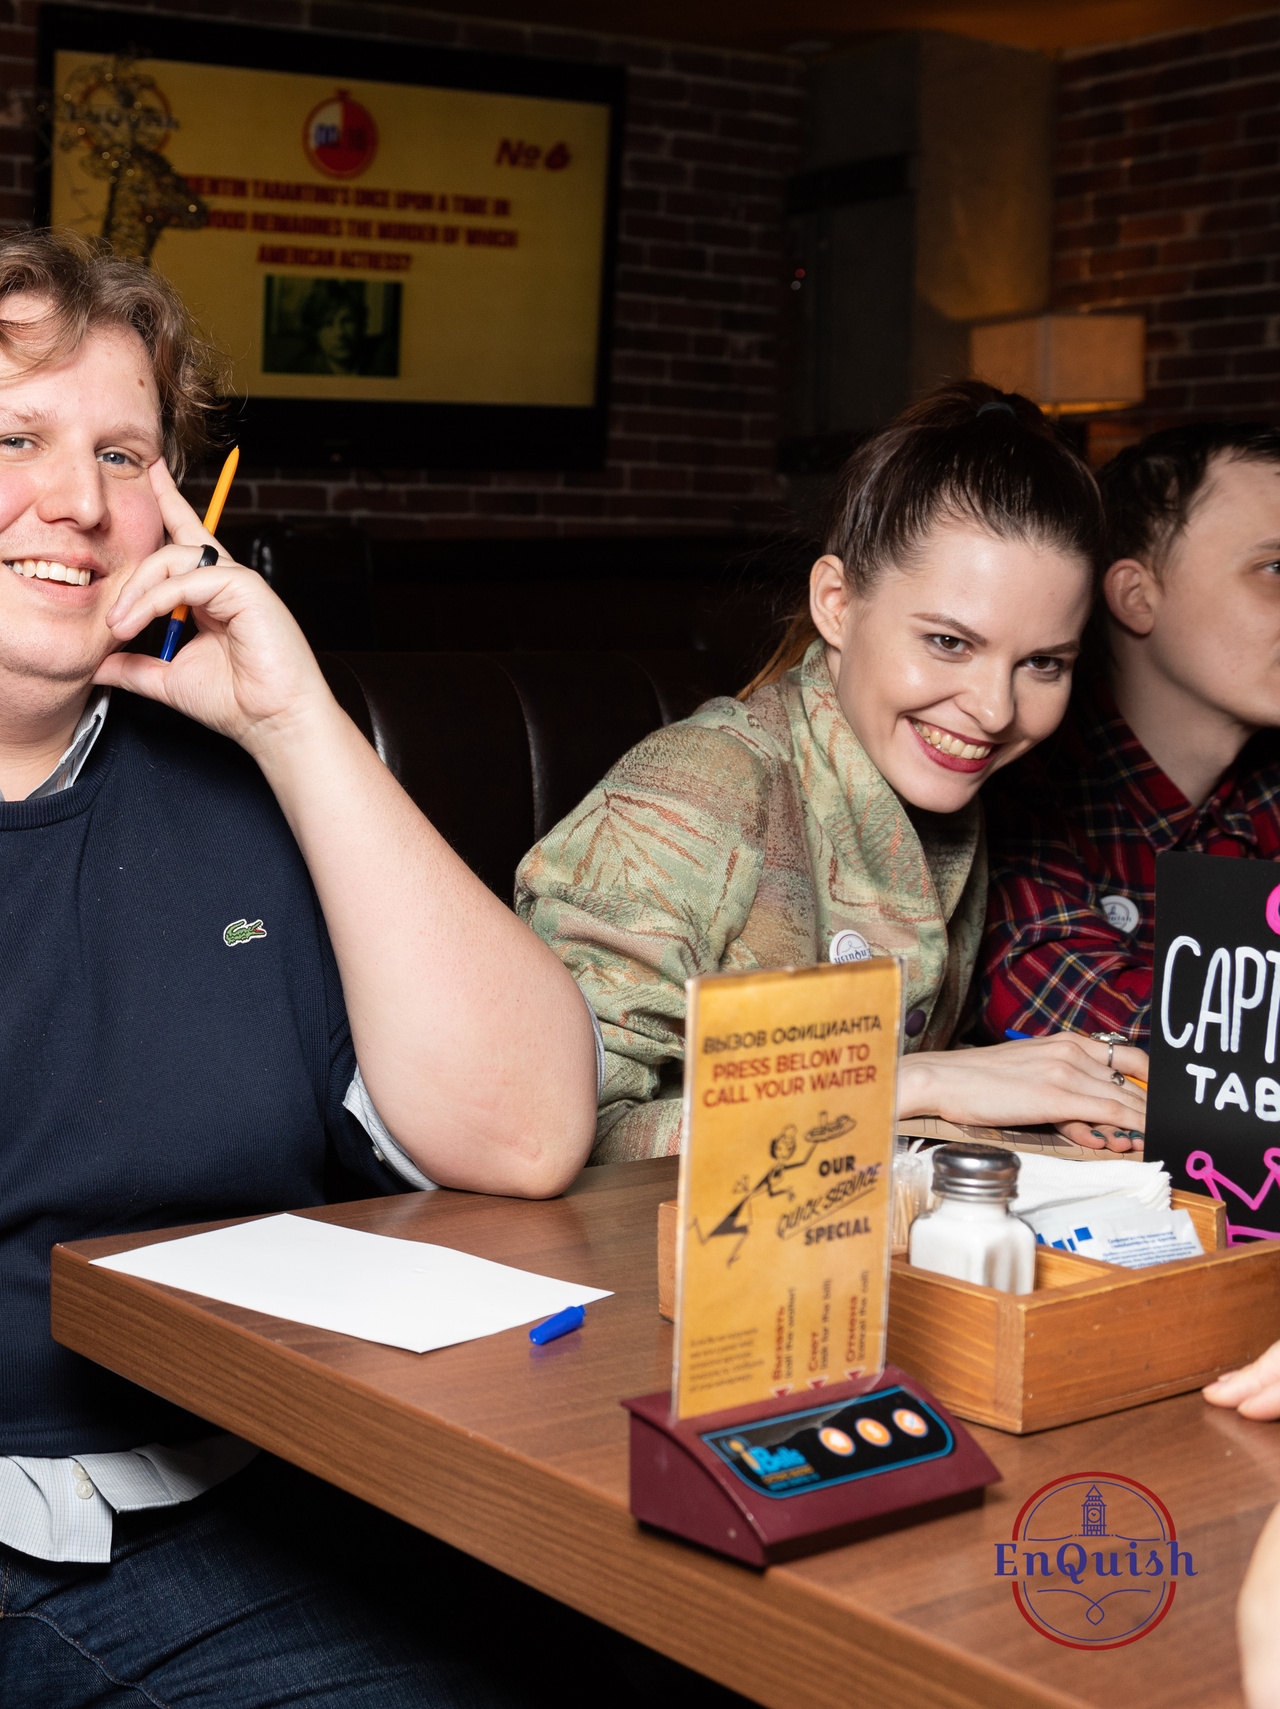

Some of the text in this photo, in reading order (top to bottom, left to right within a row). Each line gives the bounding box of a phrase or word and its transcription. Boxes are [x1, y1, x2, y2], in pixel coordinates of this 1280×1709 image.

[545, 142, 572, 171] 6
[703, 1014, 882, 1055] ВЫЗОВ ОФИЦИАНТА
[712, 1043, 870, 1082] PRESS BELOW TO
[703, 1064, 877, 1108] CALL YOUR WAITER
[819, 1155, 856, 1177] OUR
[805, 1217, 871, 1246] SPECIAL
